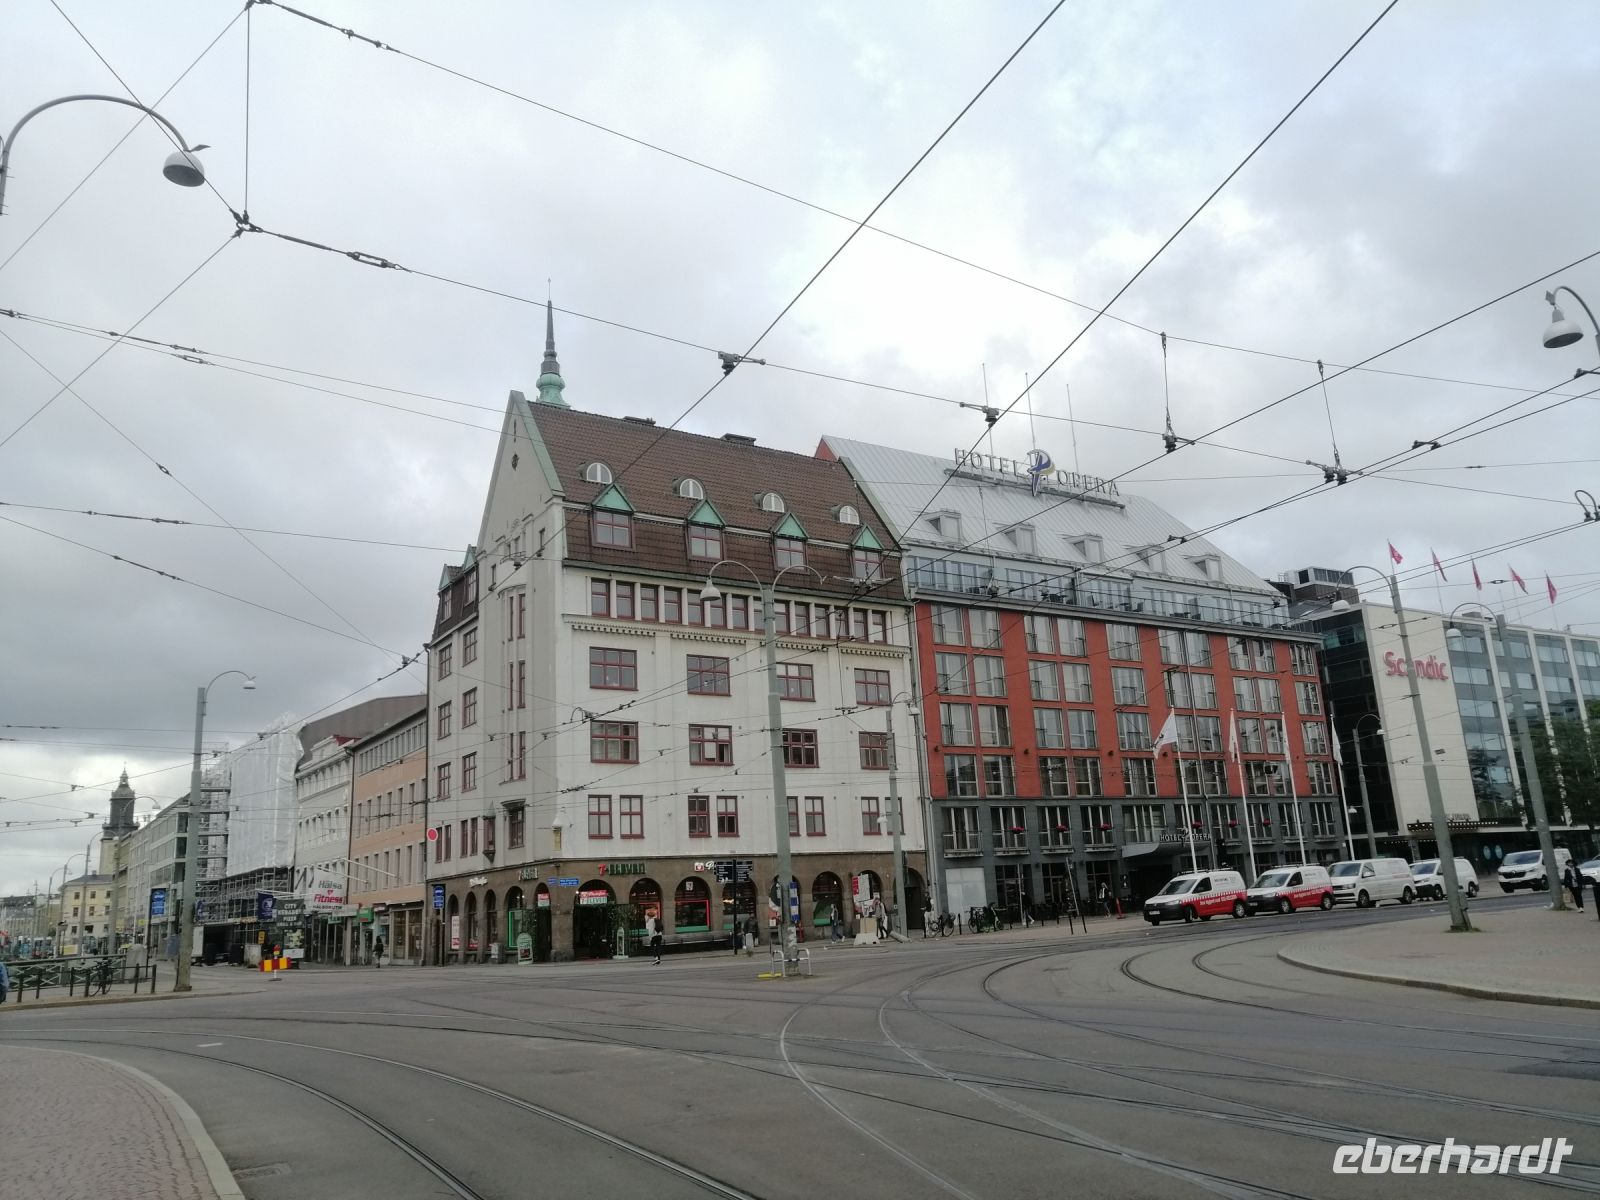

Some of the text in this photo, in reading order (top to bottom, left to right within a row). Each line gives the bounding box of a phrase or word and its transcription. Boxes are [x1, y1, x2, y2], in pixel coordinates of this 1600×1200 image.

[954, 447, 1120, 497] HOTEL OPERA
[1383, 651, 1448, 680] Scndic
[1160, 833, 1182, 842] HOTEL
[314, 893, 343, 904] Fitness
